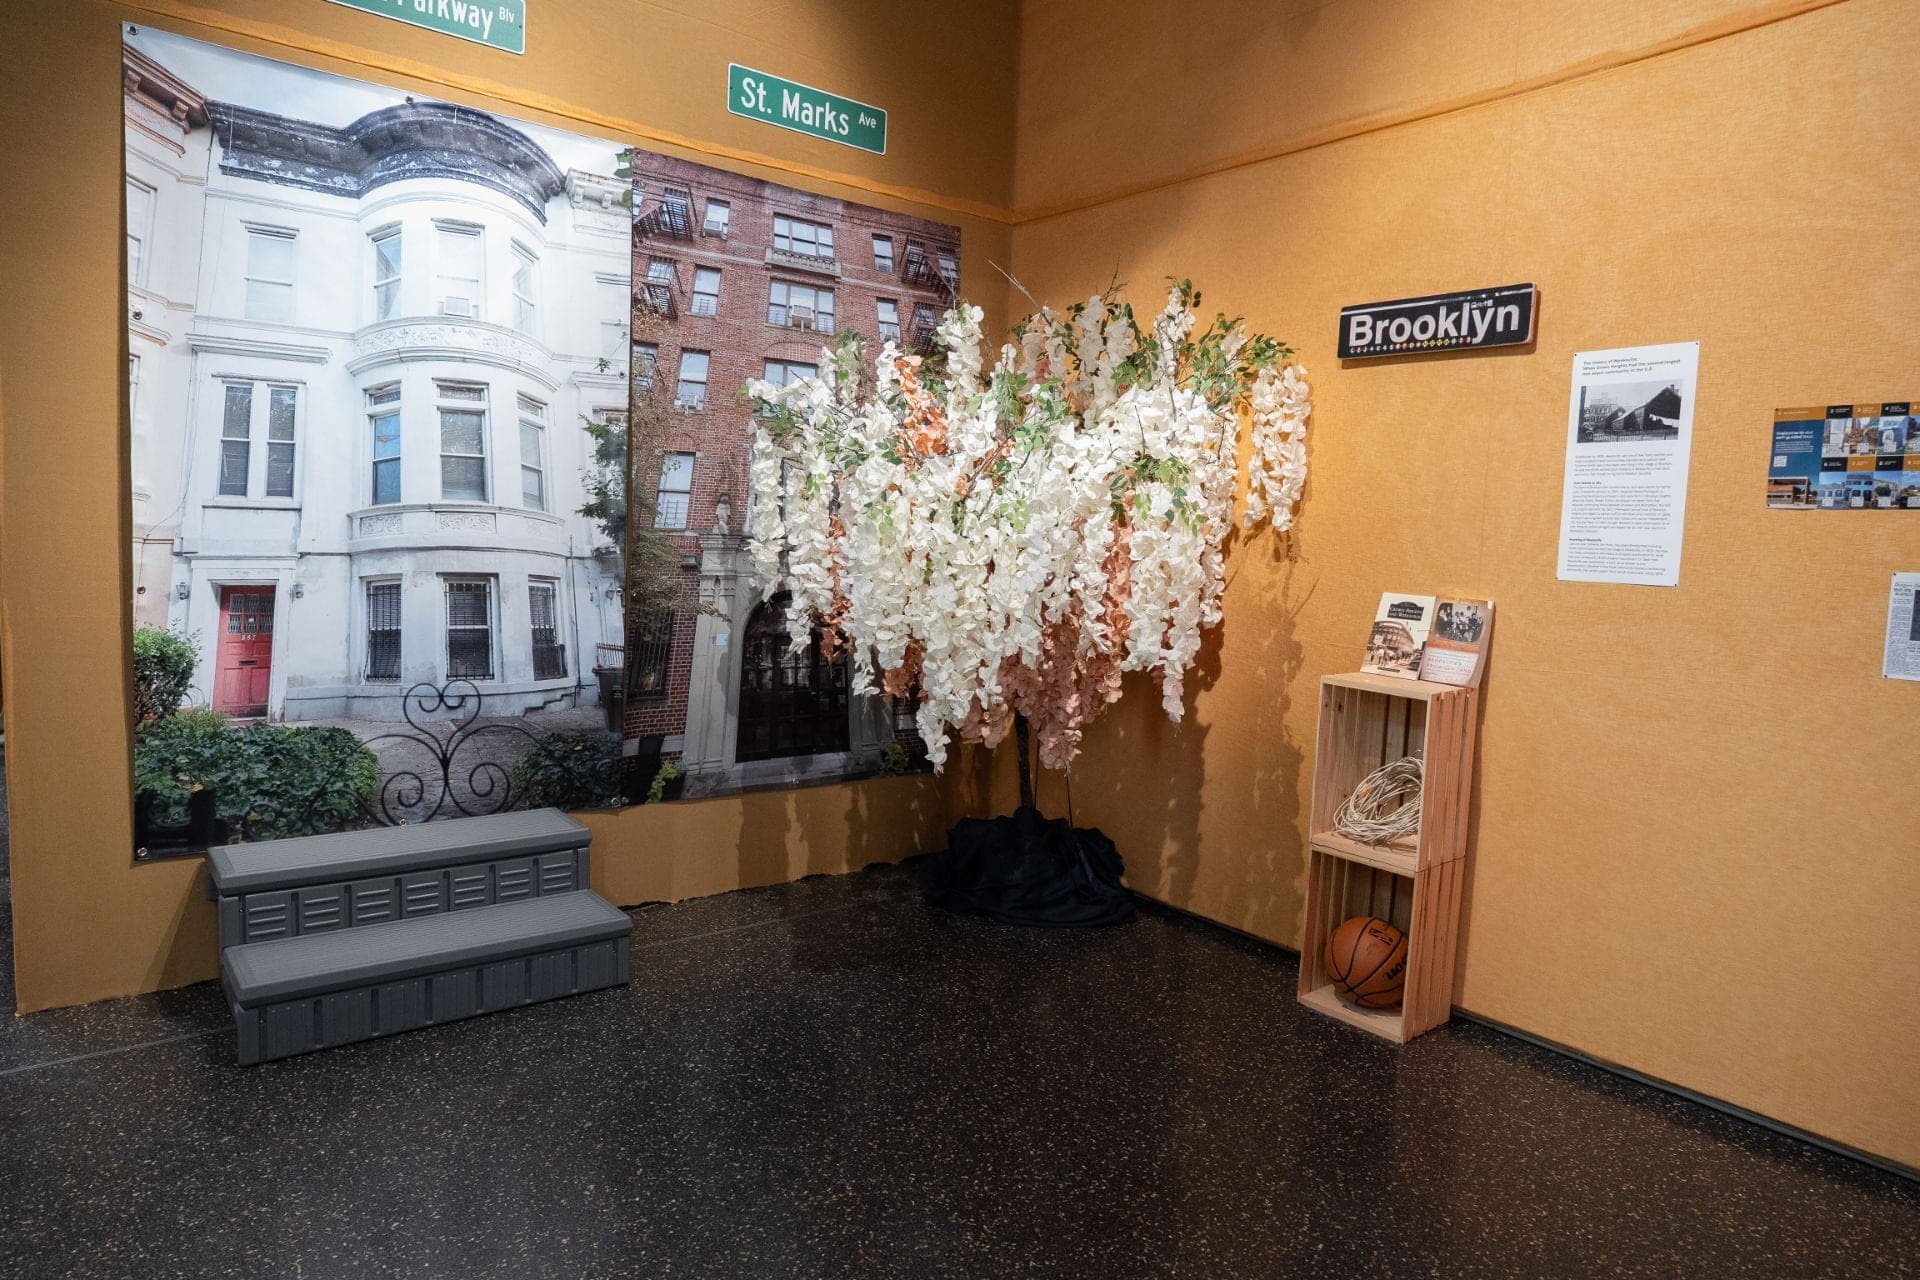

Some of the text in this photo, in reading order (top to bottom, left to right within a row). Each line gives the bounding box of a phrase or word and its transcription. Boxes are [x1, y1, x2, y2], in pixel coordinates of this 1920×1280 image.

[397, 0, 515, 40] arkway Blv
[740, 77, 877, 136] St. Marks Ave
[1349, 302, 1520, 347] Brooklyn
